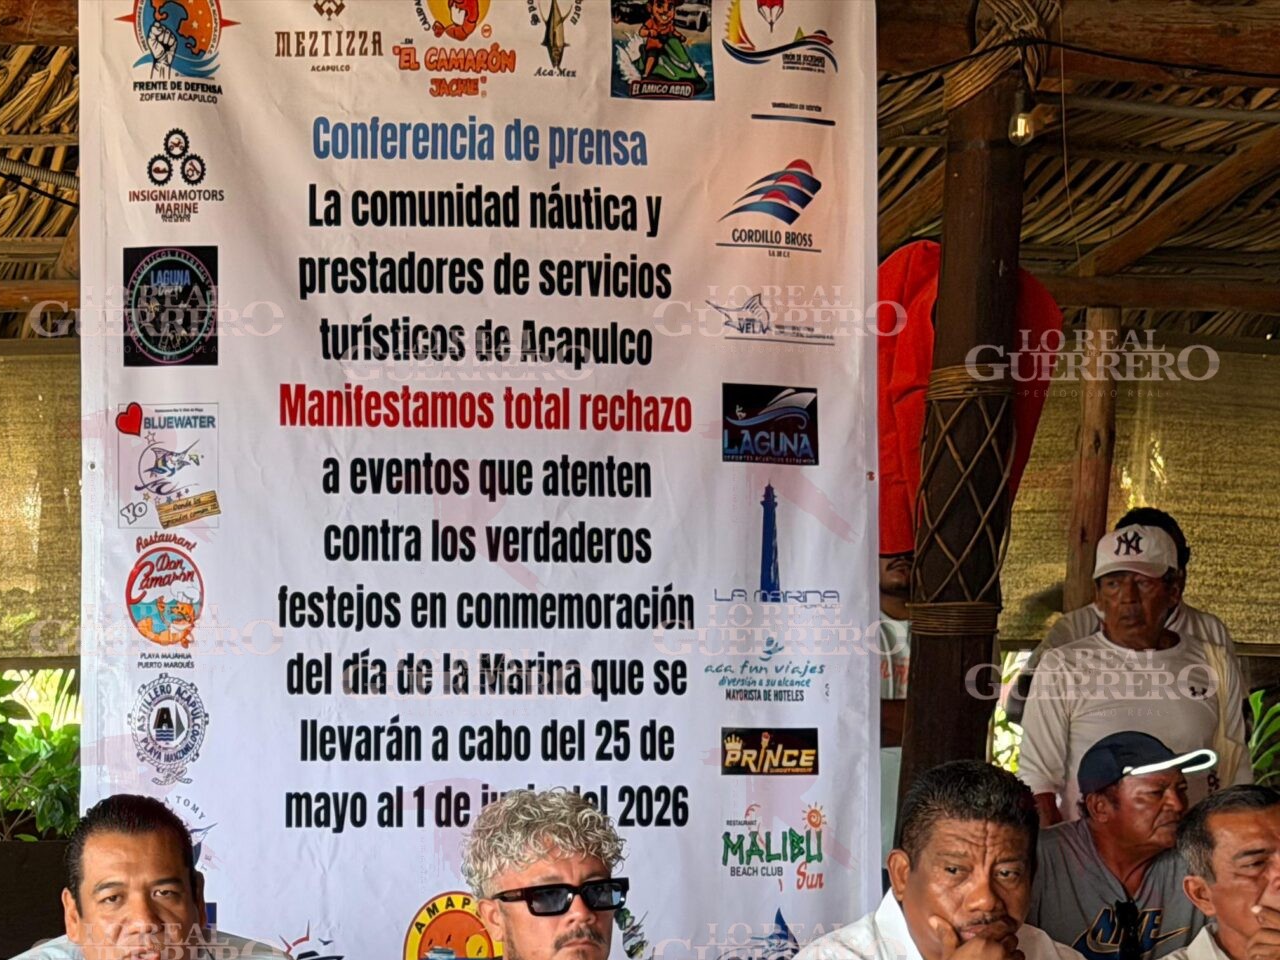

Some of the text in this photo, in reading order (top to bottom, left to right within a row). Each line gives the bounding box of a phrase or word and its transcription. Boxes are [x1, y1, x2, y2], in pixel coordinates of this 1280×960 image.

[274, 30, 383, 58] MEZTIZZA
[133, 81, 223, 94] FRENTE DE DEFENSA
[140, 93, 217, 104] ZOFEMAT ACAPULCO
[314, 116, 647, 169] Conferencia de prensa
[128, 189, 225, 202] INSIGNIAMOTORS
[155, 202, 199, 214] MARINE
[309, 182, 662, 237] La comunidad náutica y
[732, 228, 813, 247] GORDILLO BROSS
[299, 251, 671, 300] prestadores de servicios
[320, 314, 652, 370] turísticos de Acapulco
[280, 383, 691, 432] Manifestamos total rechazo
[144, 416, 216, 429] BLUEWATER
[723, 429, 814, 458] LAGUNA
[323, 453, 651, 502] a eventos que atenten
[120, 502, 148, 525] YO
[136, 531, 197, 553] Restaurant
[324, 520, 651, 563] contra los verdaderos
[156, 552, 184, 572] Don
[279, 583, 694, 631] festejos en conmemoración
[287, 649, 686, 701] del día de la Marina que se
[775, 660, 825, 677] viajes
[725, 688, 805, 702] MAYORISTA DE HOTELES
[301, 715, 674, 761] llevarán a cabo del 25 de
[724, 744, 817, 773] PRINCE
[286, 792, 366, 833] mayo
[378, 786, 403, 827] al
[414, 786, 424, 827] 1
[435, 786, 470, 827] de
[618, 786, 688, 826] 2026
[722, 827, 824, 866] MALIBU
[730, 866, 783, 877] BEACH CLUB
